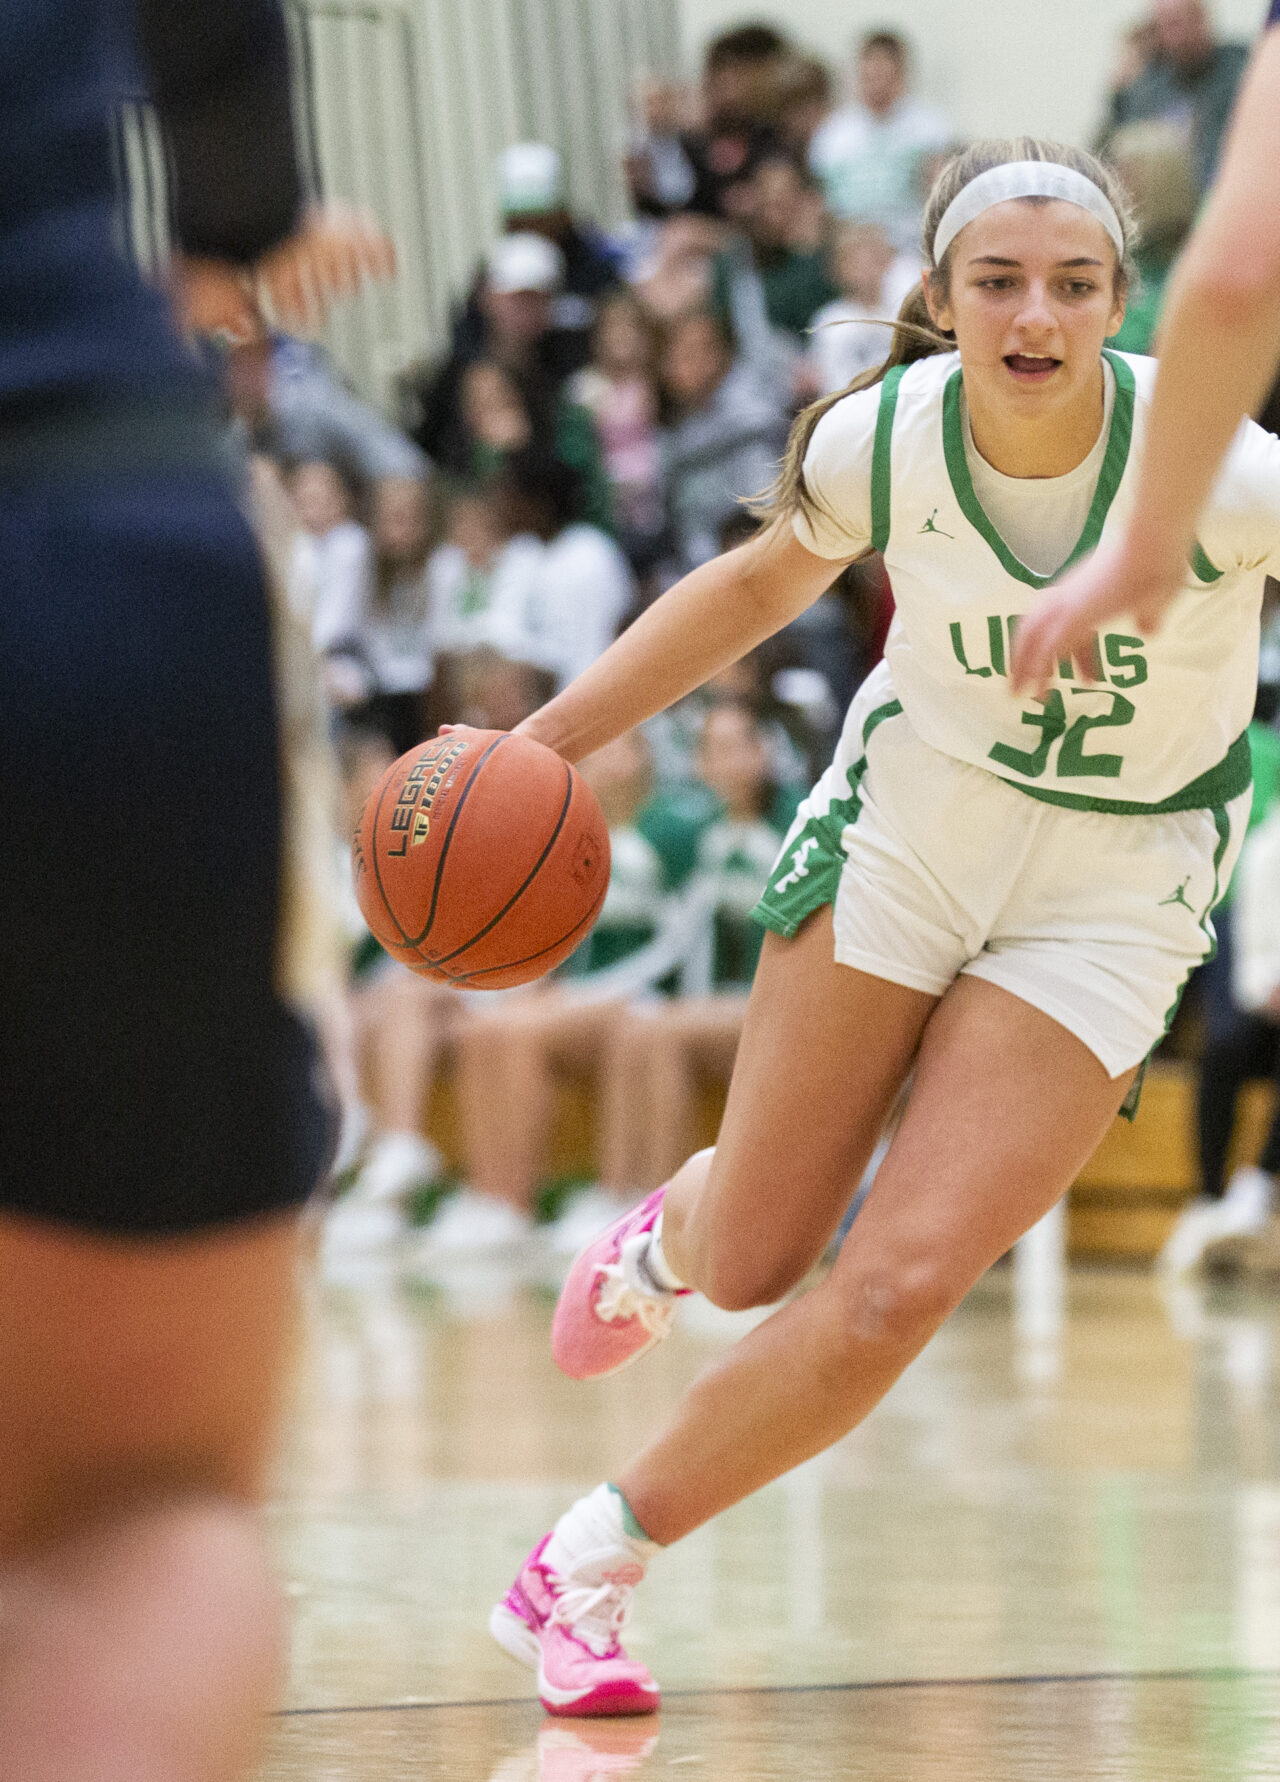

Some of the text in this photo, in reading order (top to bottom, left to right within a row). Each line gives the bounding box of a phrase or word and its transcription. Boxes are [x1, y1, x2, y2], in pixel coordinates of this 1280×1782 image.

[949, 614, 1148, 689] LIS
[987, 687, 1136, 778] 32
[387, 736, 455, 857] LEGACY
[420, 742, 467, 810] 1000
